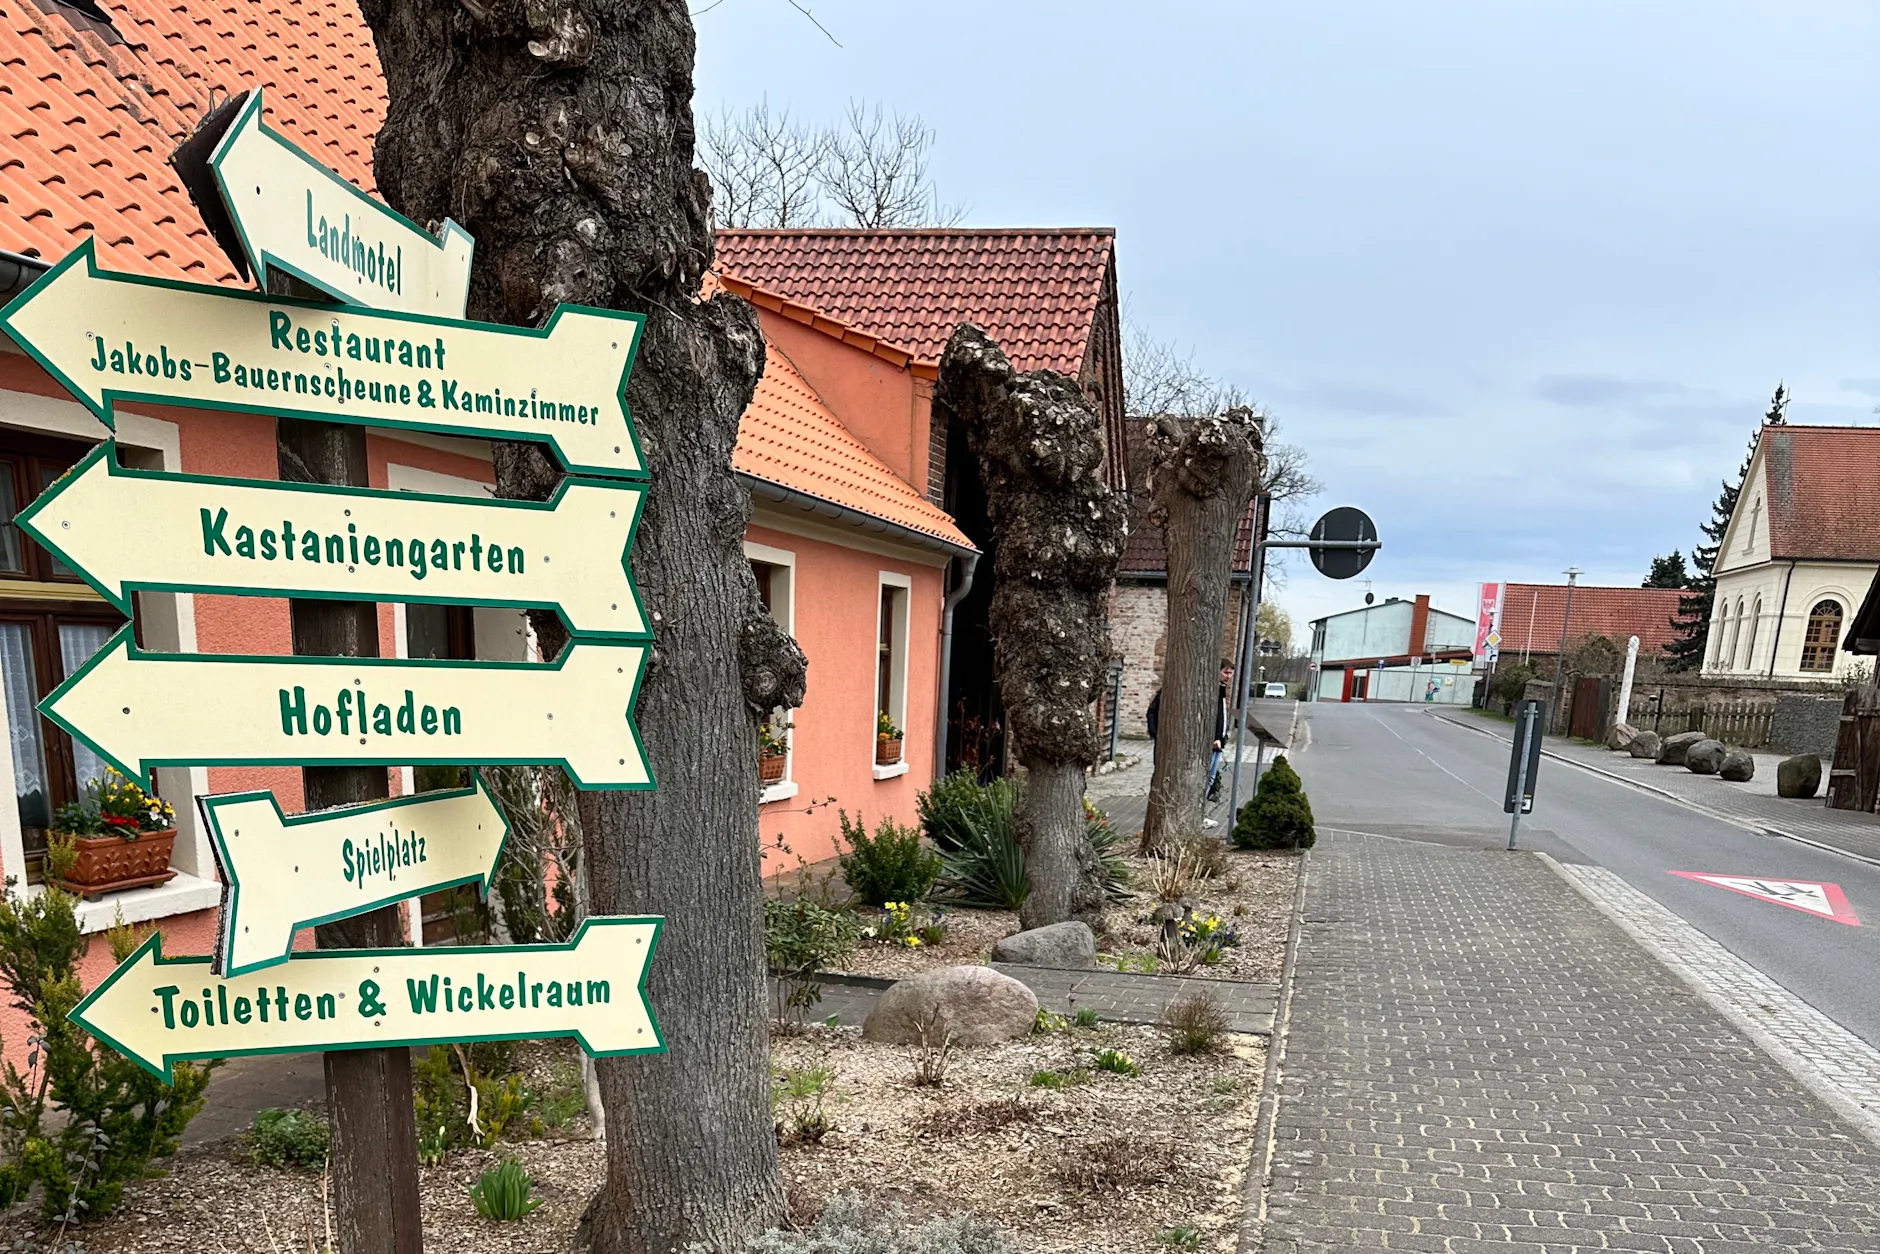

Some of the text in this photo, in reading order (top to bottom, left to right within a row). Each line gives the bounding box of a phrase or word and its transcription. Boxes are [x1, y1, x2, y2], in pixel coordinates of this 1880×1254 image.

[306, 188, 402, 297] Landmotel
[269, 310, 446, 370] Restaurant
[90, 335, 600, 426] Jakobs-Bauernscheune & Kaminzimmer
[199, 507, 525, 581] Kastaniengarten
[279, 685, 462, 736] Hofladen
[342, 828, 427, 889] Spielplatz
[153, 971, 611, 1031] Toiletten & Wickelraum
